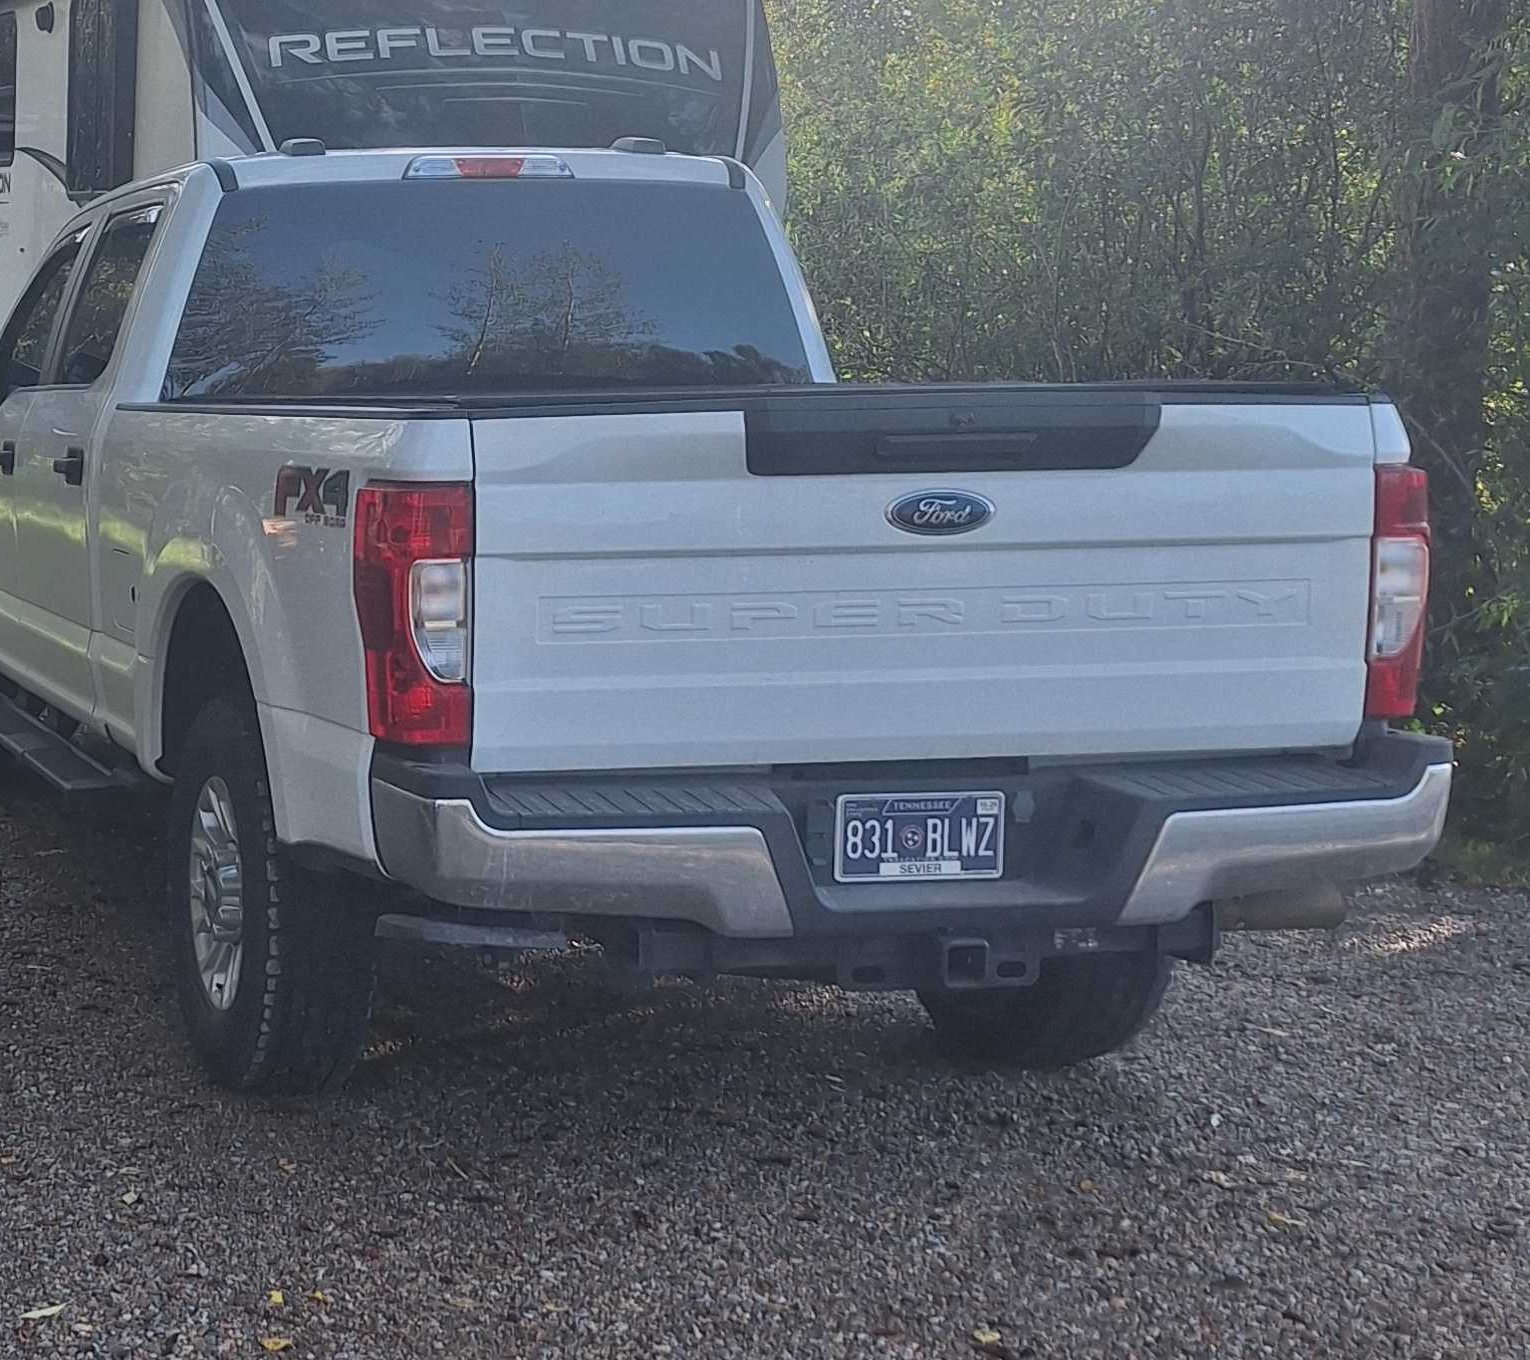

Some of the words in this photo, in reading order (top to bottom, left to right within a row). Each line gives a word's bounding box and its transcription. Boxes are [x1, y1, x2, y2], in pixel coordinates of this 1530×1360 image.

[268, 25, 723, 81] REFLECTION
[274, 465, 350, 517] FX4
[913, 499, 971, 524] Ford
[552, 597, 964, 634] SUPER
[1000, 588, 1298, 623] DUTY
[893, 800, 952, 811] TENNESSEE
[846, 819, 898, 859] 831
[925, 817, 995, 858] BLWZ
[899, 863, 942, 873] SEVIER
